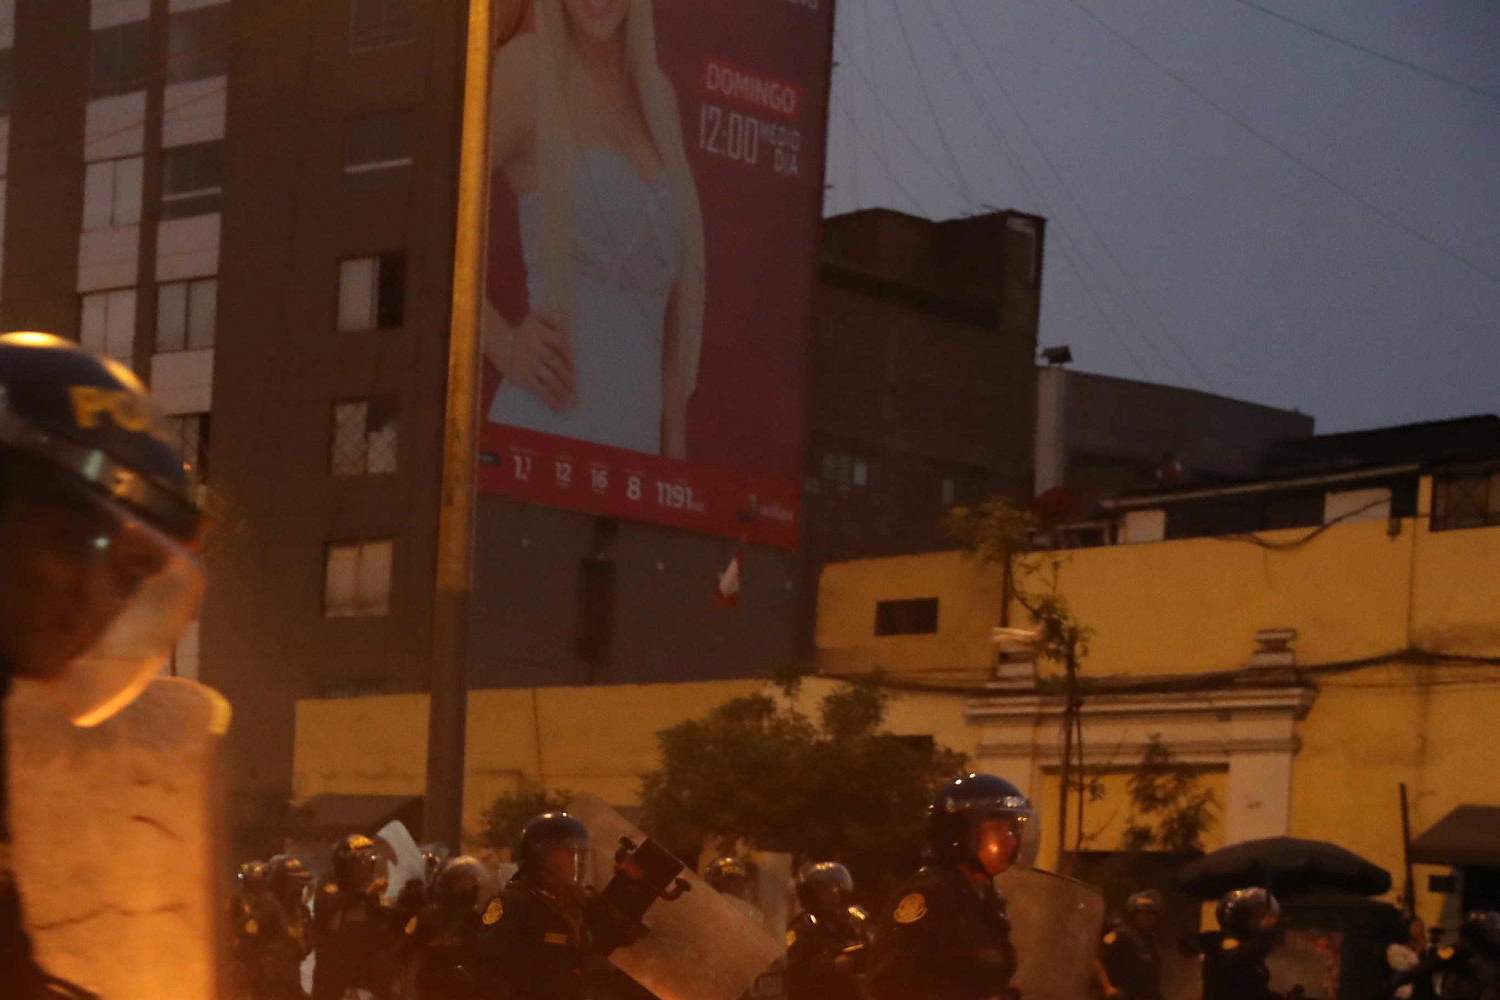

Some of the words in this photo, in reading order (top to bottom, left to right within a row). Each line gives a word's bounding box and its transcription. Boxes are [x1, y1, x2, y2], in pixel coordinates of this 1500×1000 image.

[705, 62, 797, 114] DOMINGO
[699, 103, 759, 165] 12:00
[626, 474, 643, 502] 8
